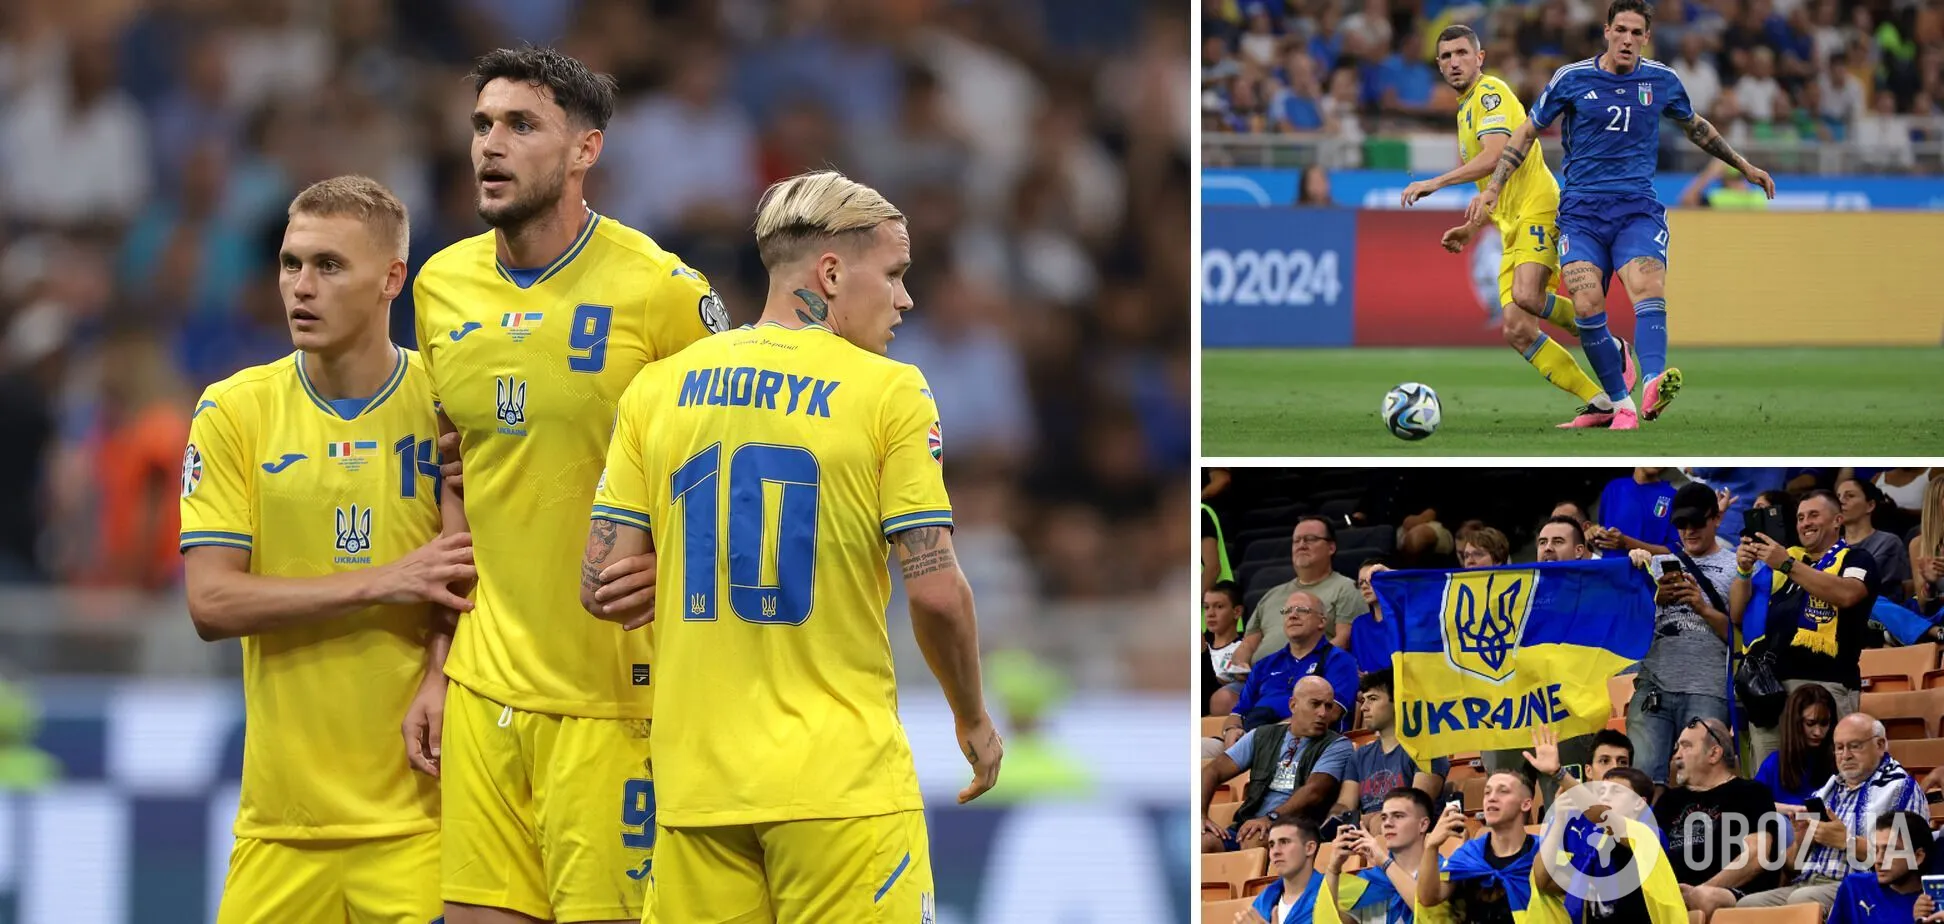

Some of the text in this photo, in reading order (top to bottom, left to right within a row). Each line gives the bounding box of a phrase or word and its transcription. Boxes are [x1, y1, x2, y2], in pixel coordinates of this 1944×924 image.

[1605, 105, 1631, 132] 21
[1529, 225, 1545, 244] 4
[1201, 248, 1342, 306] O2024
[567, 303, 614, 374] 9
[677, 366, 841, 418] MUDRYK
[394, 433, 443, 510] 14
[334, 556, 372, 564] UKRAINE
[670, 441, 820, 626] 10
[1402, 683, 1570, 737] UKRAINE
[620, 777, 657, 850] 9
